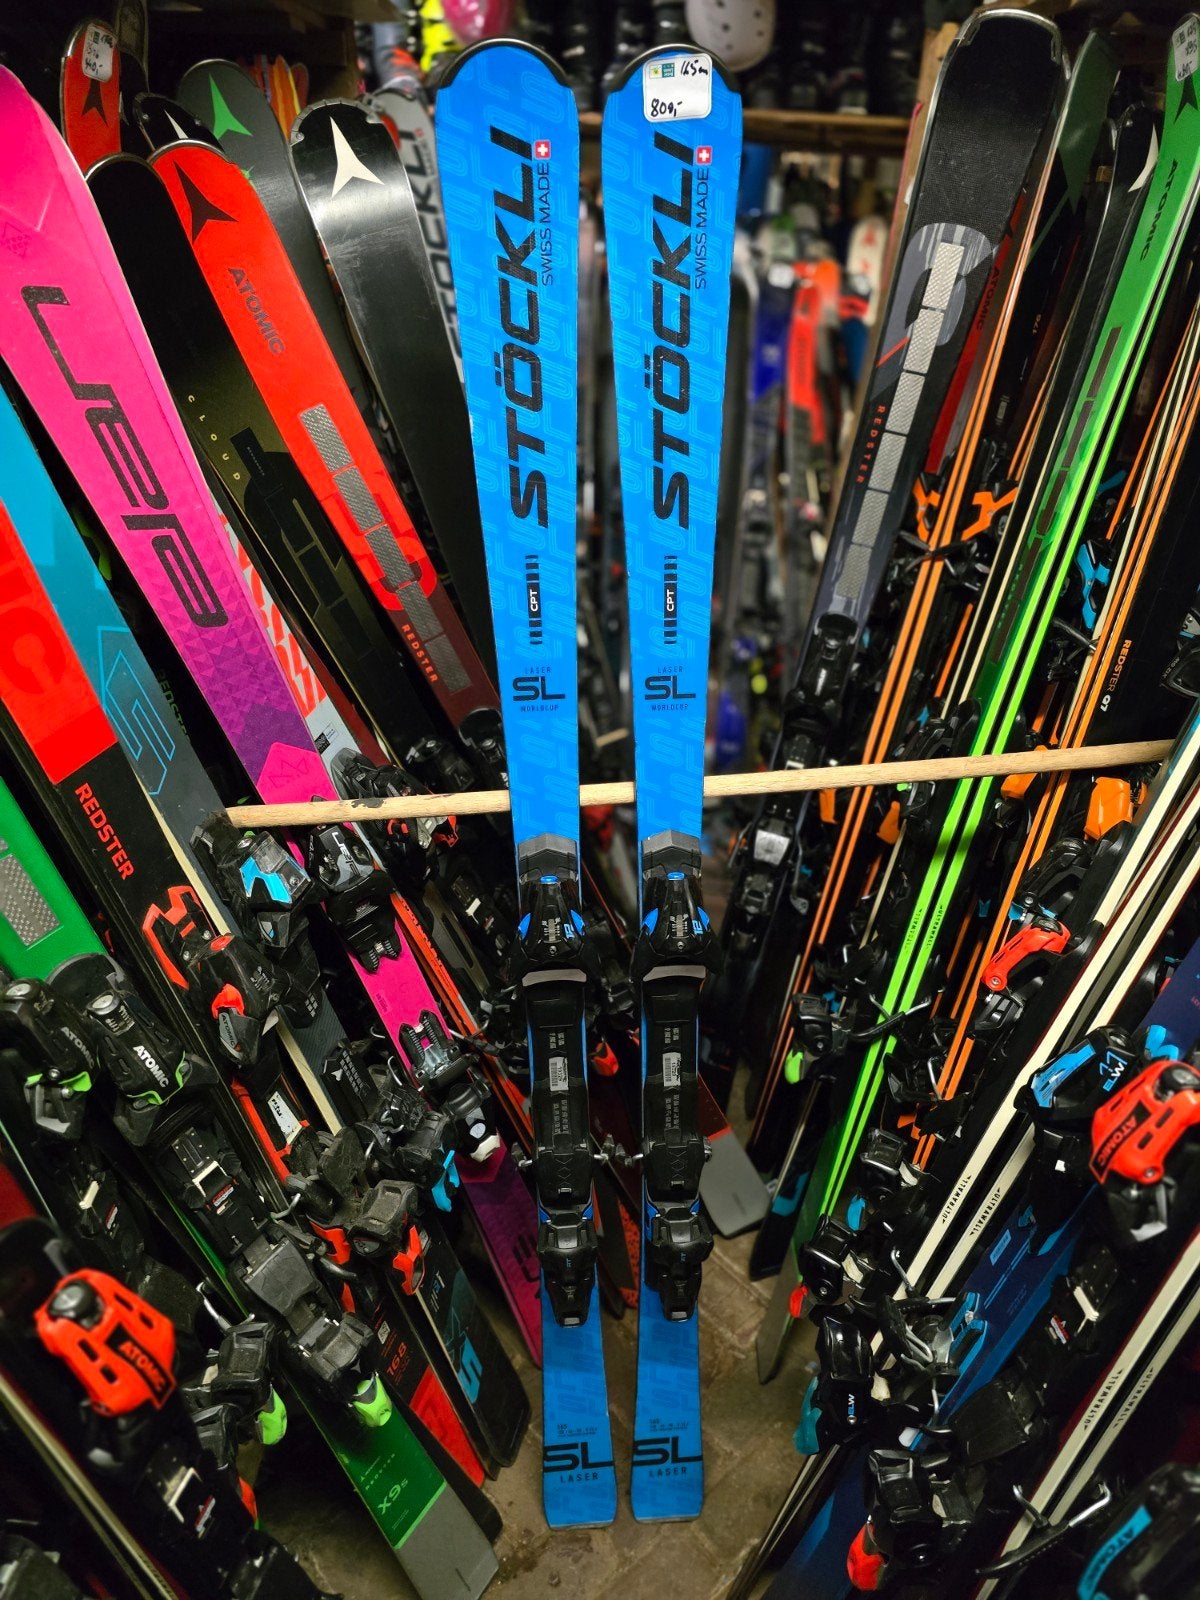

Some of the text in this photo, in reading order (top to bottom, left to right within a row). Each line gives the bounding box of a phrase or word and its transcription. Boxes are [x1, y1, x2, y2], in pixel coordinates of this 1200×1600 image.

[538, 162, 553, 286] SWISS MADE
[695, 168, 709, 290] SWISS MADE
[1140, 159, 1178, 262] ATOMIC
[228, 267, 285, 355] ATOMIC
[489, 125, 549, 529] STÖCKLI
[644, 131, 694, 530] STÖCKLI
[187, 394, 241, 481] CLOUD
[855, 404, 886, 484] REDSTER
[530, 589, 538, 612] CPT
[666, 588, 675, 612] CPT
[401, 624, 438, 683] REDSTER
[657, 665, 684, 674] LASER
[1108, 639, 1133, 692] REDSTER
[512, 676, 566, 702] SL
[644, 675, 697, 701] SL
[75, 786, 135, 880] REDSTER
[220, 1013, 237, 1047] ATOMIC
[133, 1045, 170, 1088] ATOMIC
[1098, 1117, 1137, 1167] ATOMIC
[943, 1180, 969, 1219] ULTRAWALL
[973, 1192, 999, 1232] ULTRAWALL
[119, 1339, 165, 1392] ATOMIC
[1085, 1374, 1119, 1428] ULTRAWALL
[543, 1441, 614, 1473] SL
[632, 1436, 703, 1468] SL
[648, 1466, 688, 1478] LASER
[560, 1472, 599, 1483] LASER
